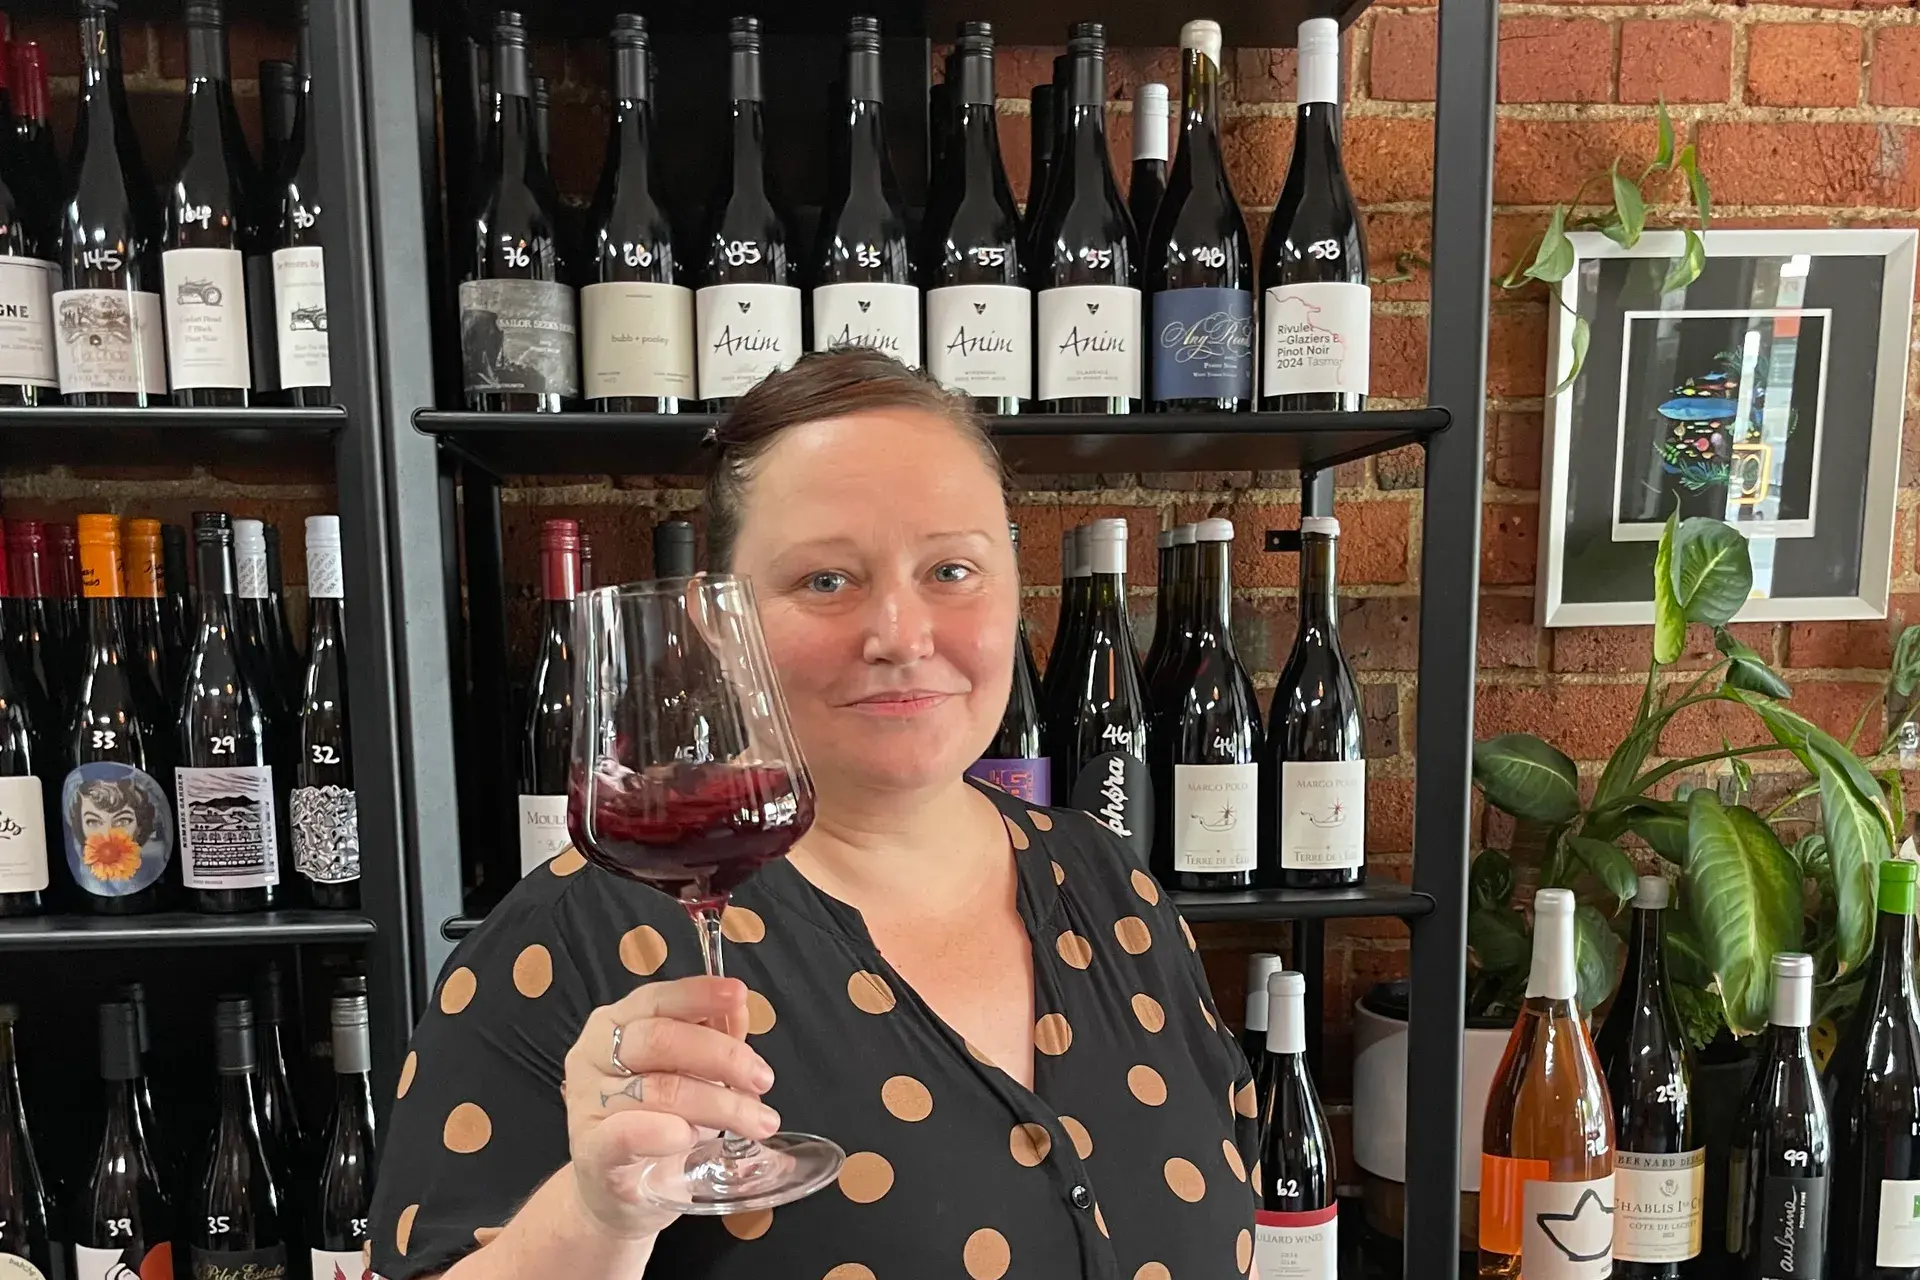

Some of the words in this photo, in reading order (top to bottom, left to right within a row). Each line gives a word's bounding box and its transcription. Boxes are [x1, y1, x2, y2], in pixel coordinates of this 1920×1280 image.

[503, 246, 530, 267] 76
[729, 240, 761, 266] 85
[978, 247, 1006, 266] 55
[1198, 246, 1226, 268] 48
[1313, 239, 1341, 260] 58
[83, 249, 122, 271] 145
[857, 250, 882, 268] 55
[1086, 249, 1112, 269] 55
[1278, 323, 1314, 334] Rivulet
[714, 325, 781, 356] Anim
[947, 326, 1013, 357] Anim
[1059, 326, 1126, 357] Anim
[1277, 347, 1304, 358] Pinot
[1306, 346, 1330, 355] Noir
[1277, 358, 1303, 369] 2024
[93, 731, 115, 749] 33
[1102, 723, 1132, 745] 46
[211, 736, 235, 754] 29
[312, 745, 340, 764] 32
[1188, 782, 1223, 792] MARCO
[1297, 780, 1333, 788] MARCO
[1185, 854, 1213, 865] TERRE
[1294, 851, 1322, 862] TERRE
[1618, 1155, 1676, 1168] BERNARD
[1784, 1150, 1808, 1167] 99
[1276, 1178, 1299, 1197] 62
[1614, 1198, 1674, 1213] HABLIS
[107, 1218, 133, 1236] 39
[207, 1216, 230, 1234] 35
